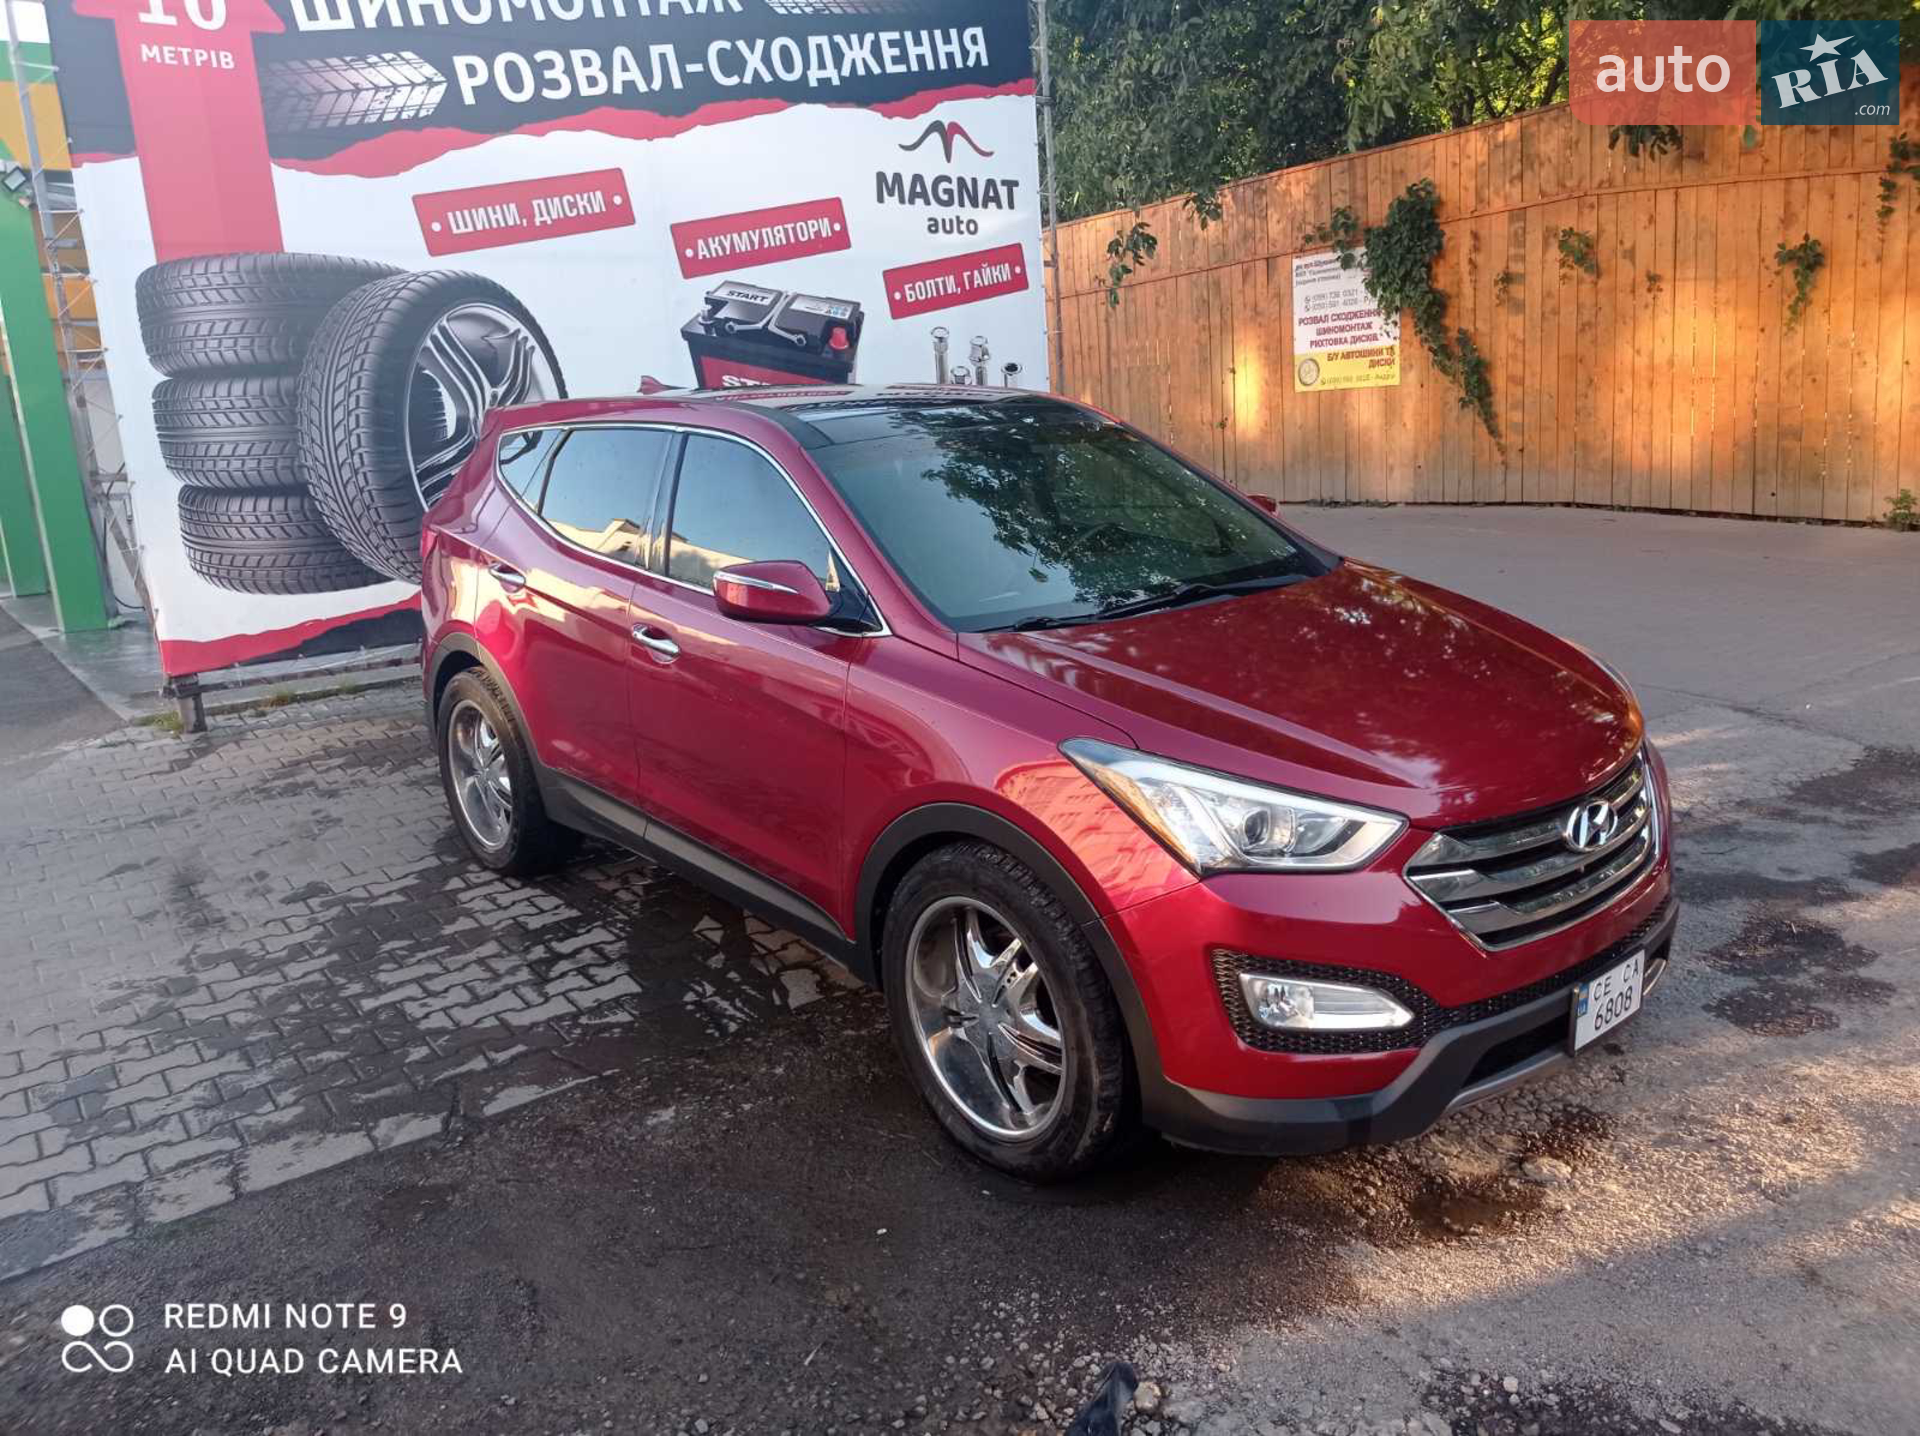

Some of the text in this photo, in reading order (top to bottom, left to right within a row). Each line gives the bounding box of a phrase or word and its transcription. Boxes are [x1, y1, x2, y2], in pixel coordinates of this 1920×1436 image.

[140, 43, 236, 70] МЕТРІВ
[451, 26, 991, 106] РОЗВАЛ-СХОДЖЕННЯ
[875, 171, 1020, 211] MAGNAT
[446, 190, 607, 235] ШИНИ, ДИСКИ
[926, 214, 979, 236] auto
[697, 217, 833, 260] АКУМУЛЯТОРИ
[728, 289, 769, 303] START
[903, 262, 1012, 303] БОЛТИ, ГАЙКИ
[1297, 313, 1329, 327] РОЗВАЛ
[1594, 984, 1634, 1031] 6808
